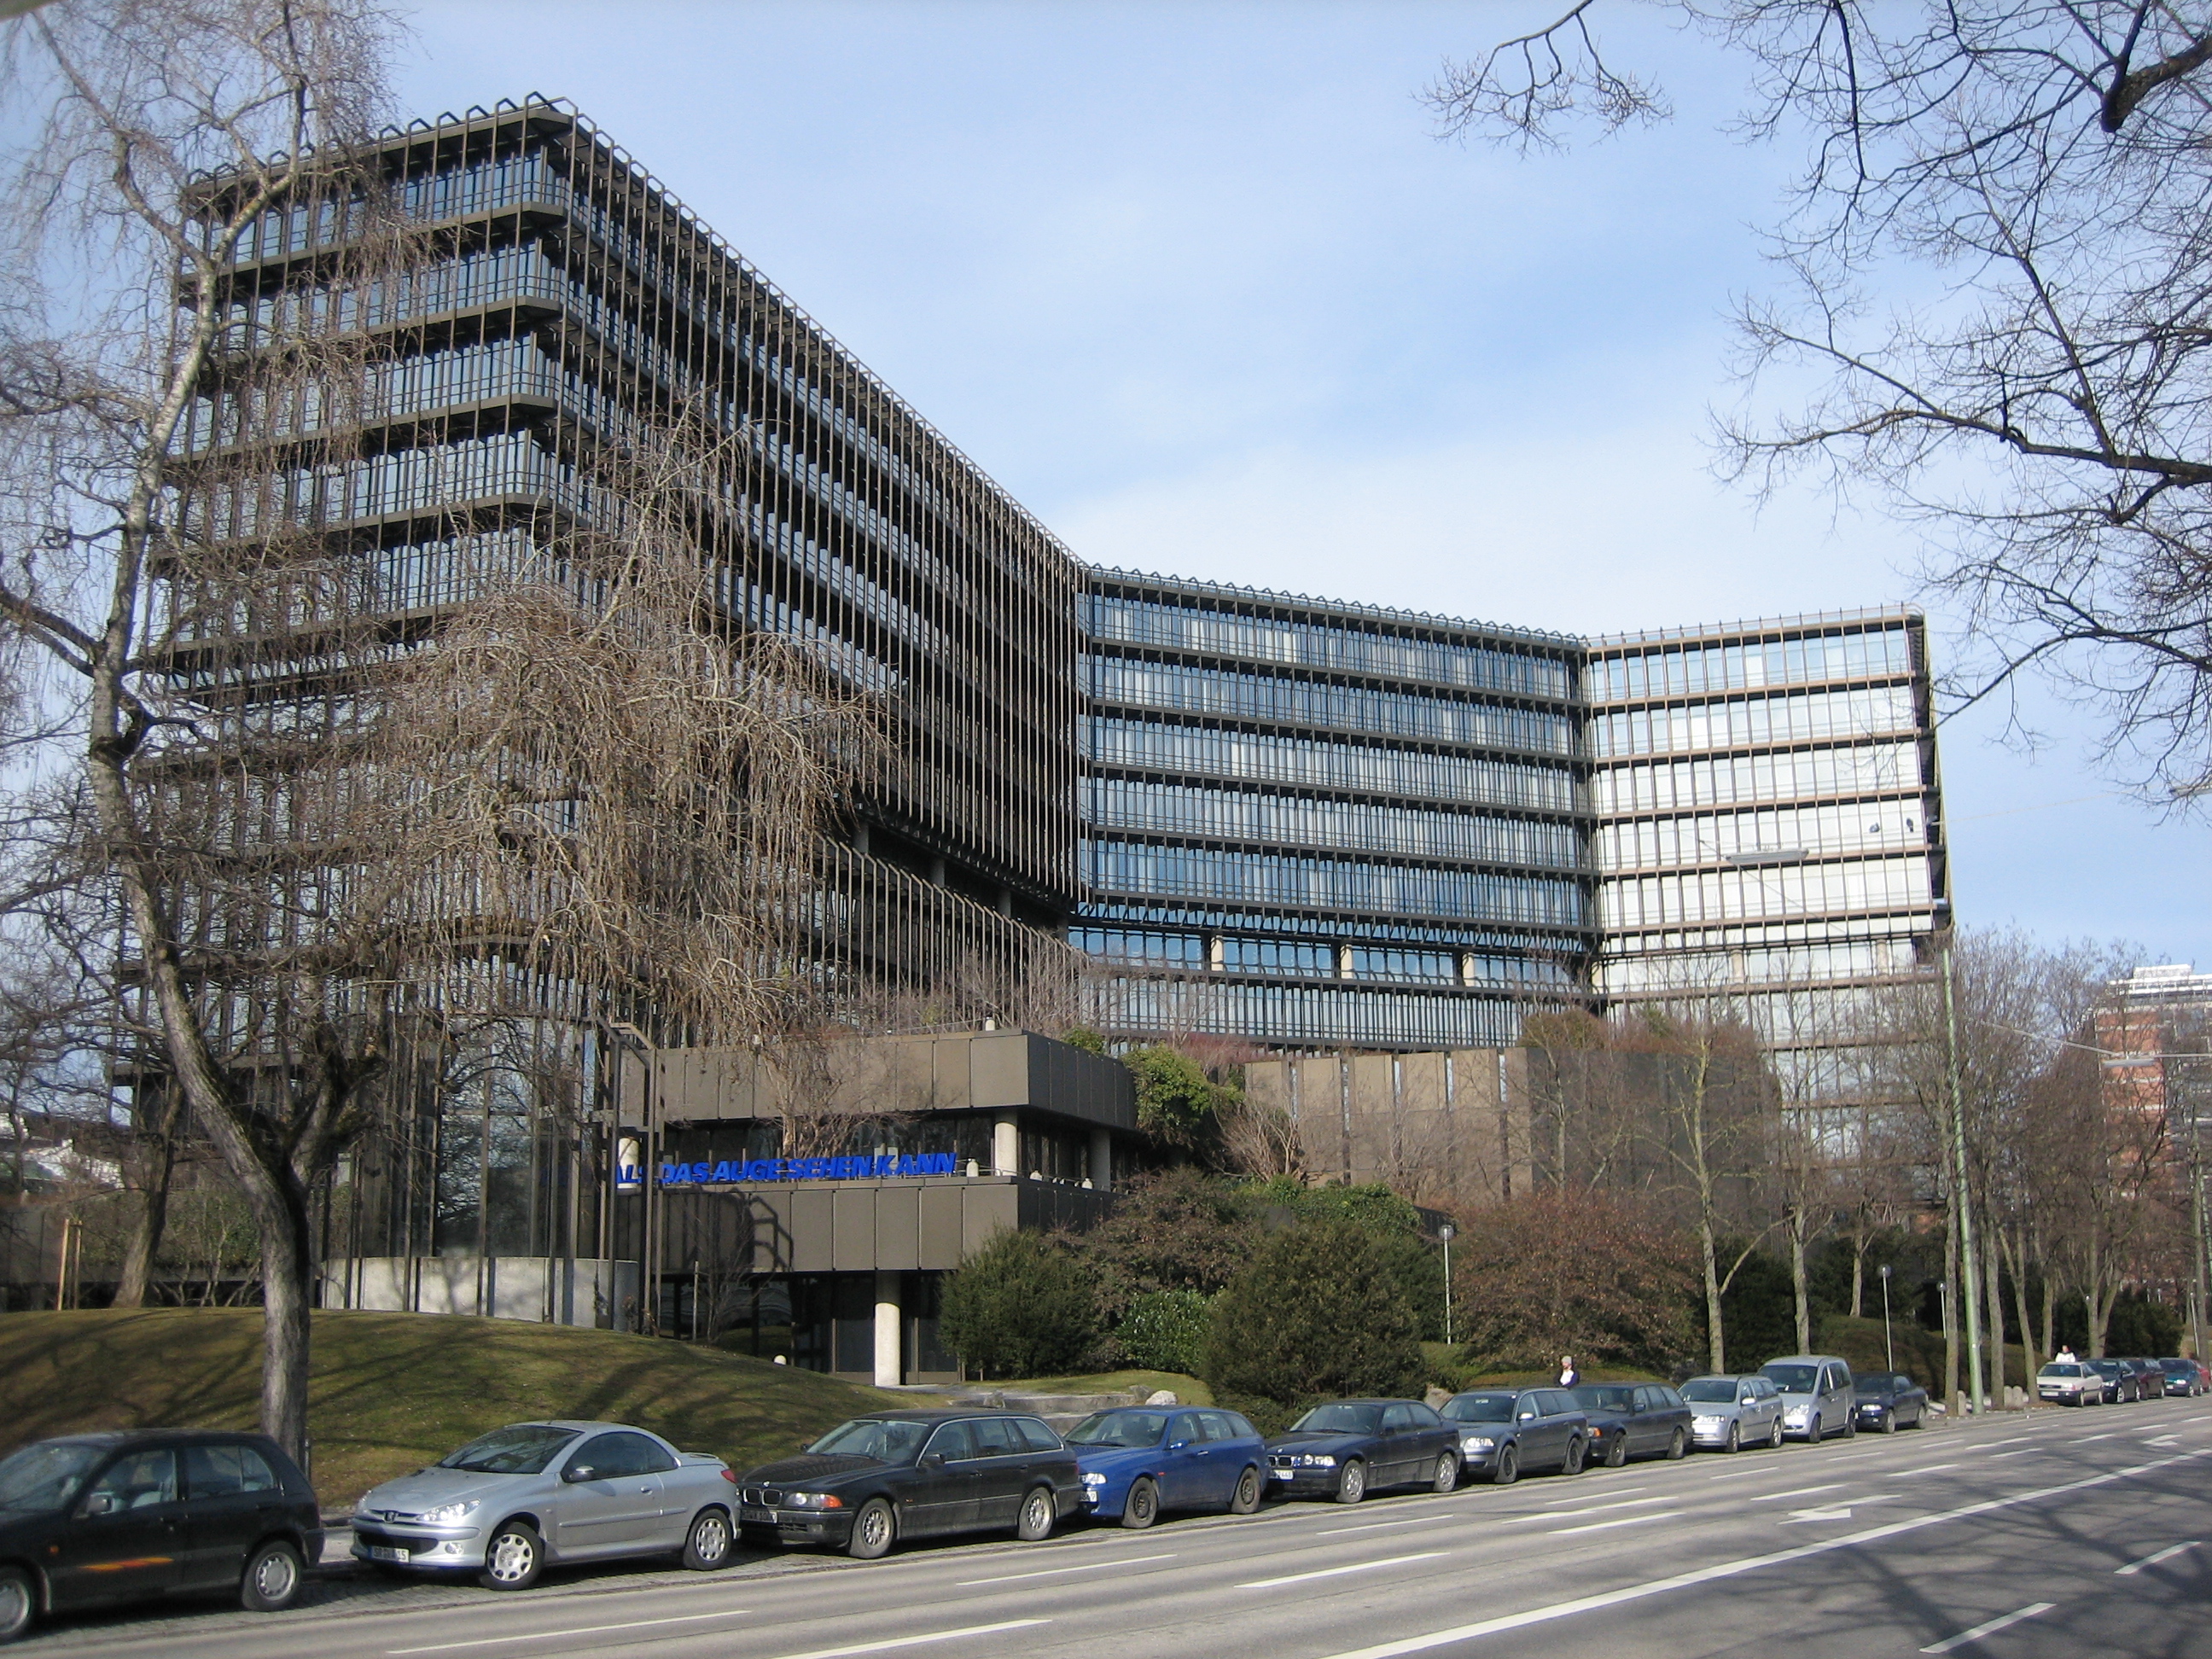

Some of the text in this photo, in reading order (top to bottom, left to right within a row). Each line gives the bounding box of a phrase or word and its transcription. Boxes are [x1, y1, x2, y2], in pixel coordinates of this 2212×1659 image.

[659, 1161, 710, 1185] DAS
[711, 1159, 784, 1181] AUGE
[785, 1155, 873, 1179] SEHEN
[873, 1152, 958, 1176] KANN
